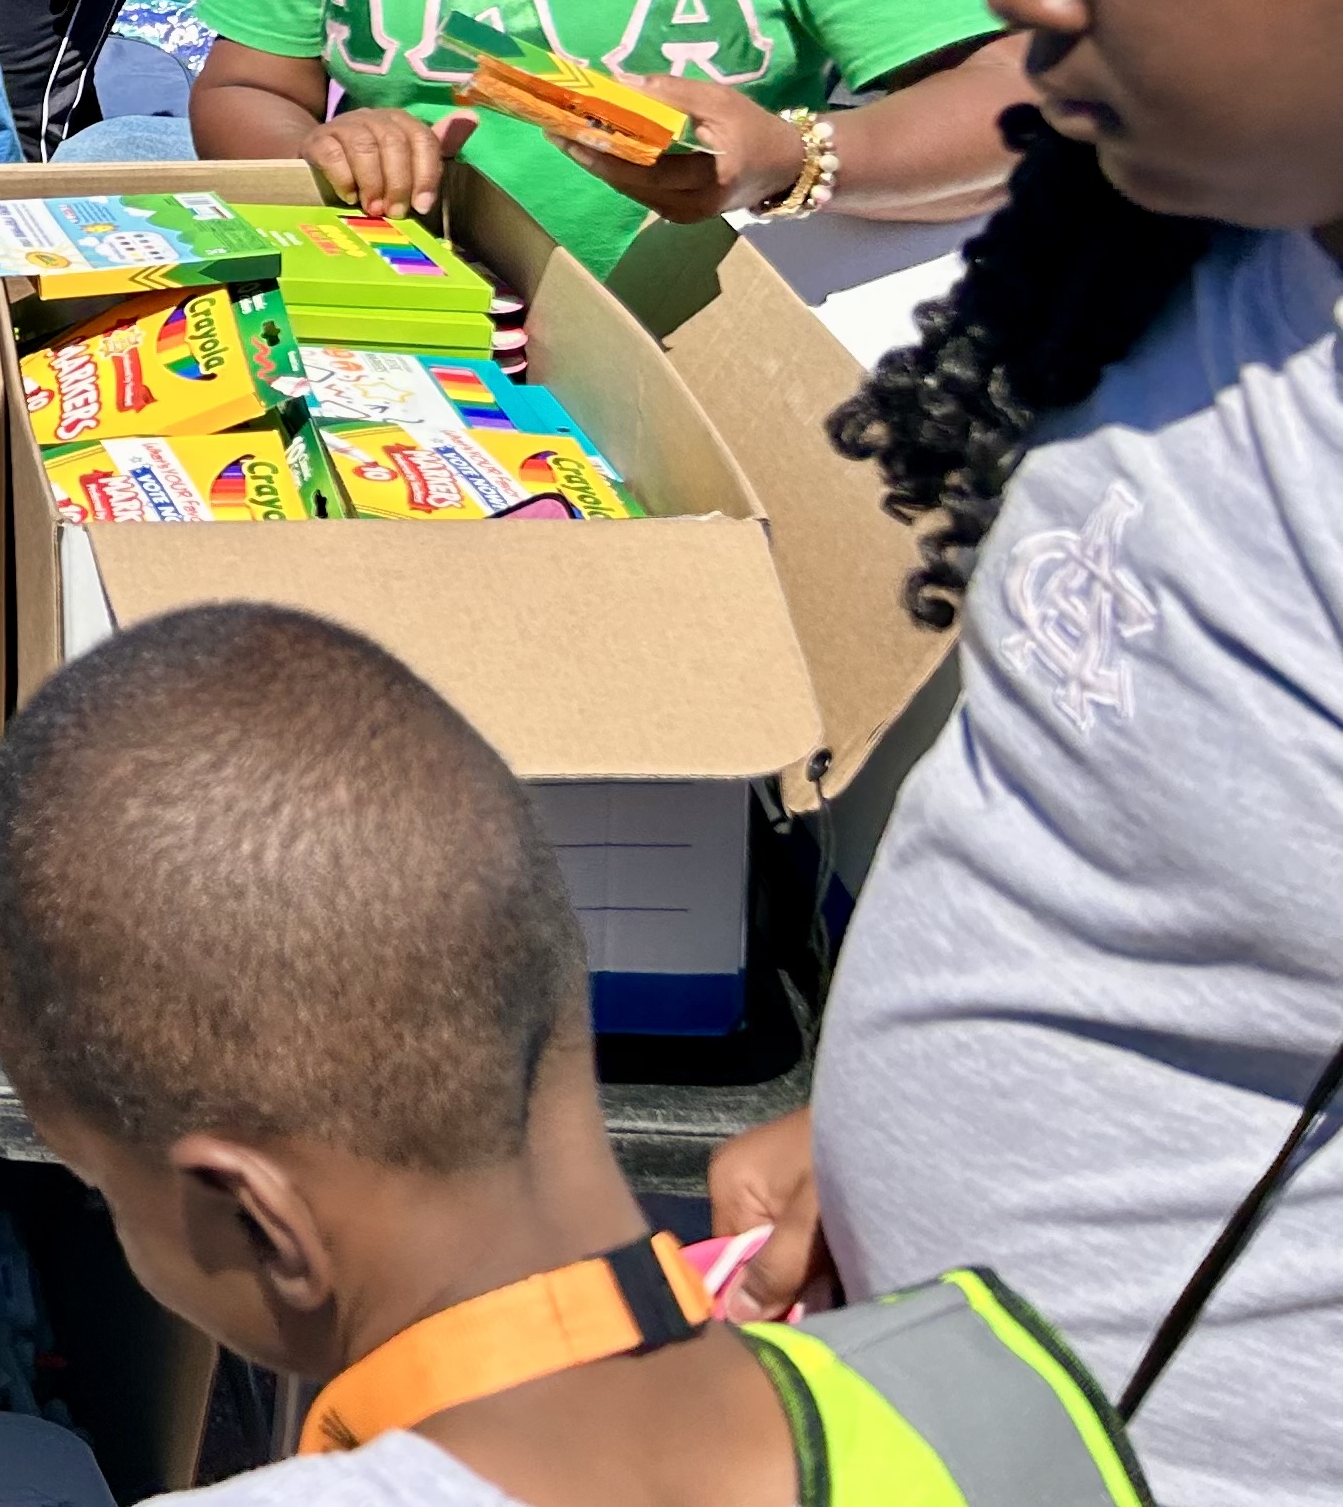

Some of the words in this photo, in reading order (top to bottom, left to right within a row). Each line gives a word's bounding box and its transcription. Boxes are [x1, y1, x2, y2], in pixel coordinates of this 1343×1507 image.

[188, 296, 230, 374] Crayola
[26, 395, 49, 413] 10
[50, 344, 101, 441] MARKERS
[363, 465, 386, 481] 10
[445, 447, 477, 476] VOTE
[137, 473, 164, 501] VOTE
[163, 467, 194, 500] YOUR
[403, 448, 465, 509] MARKERS
